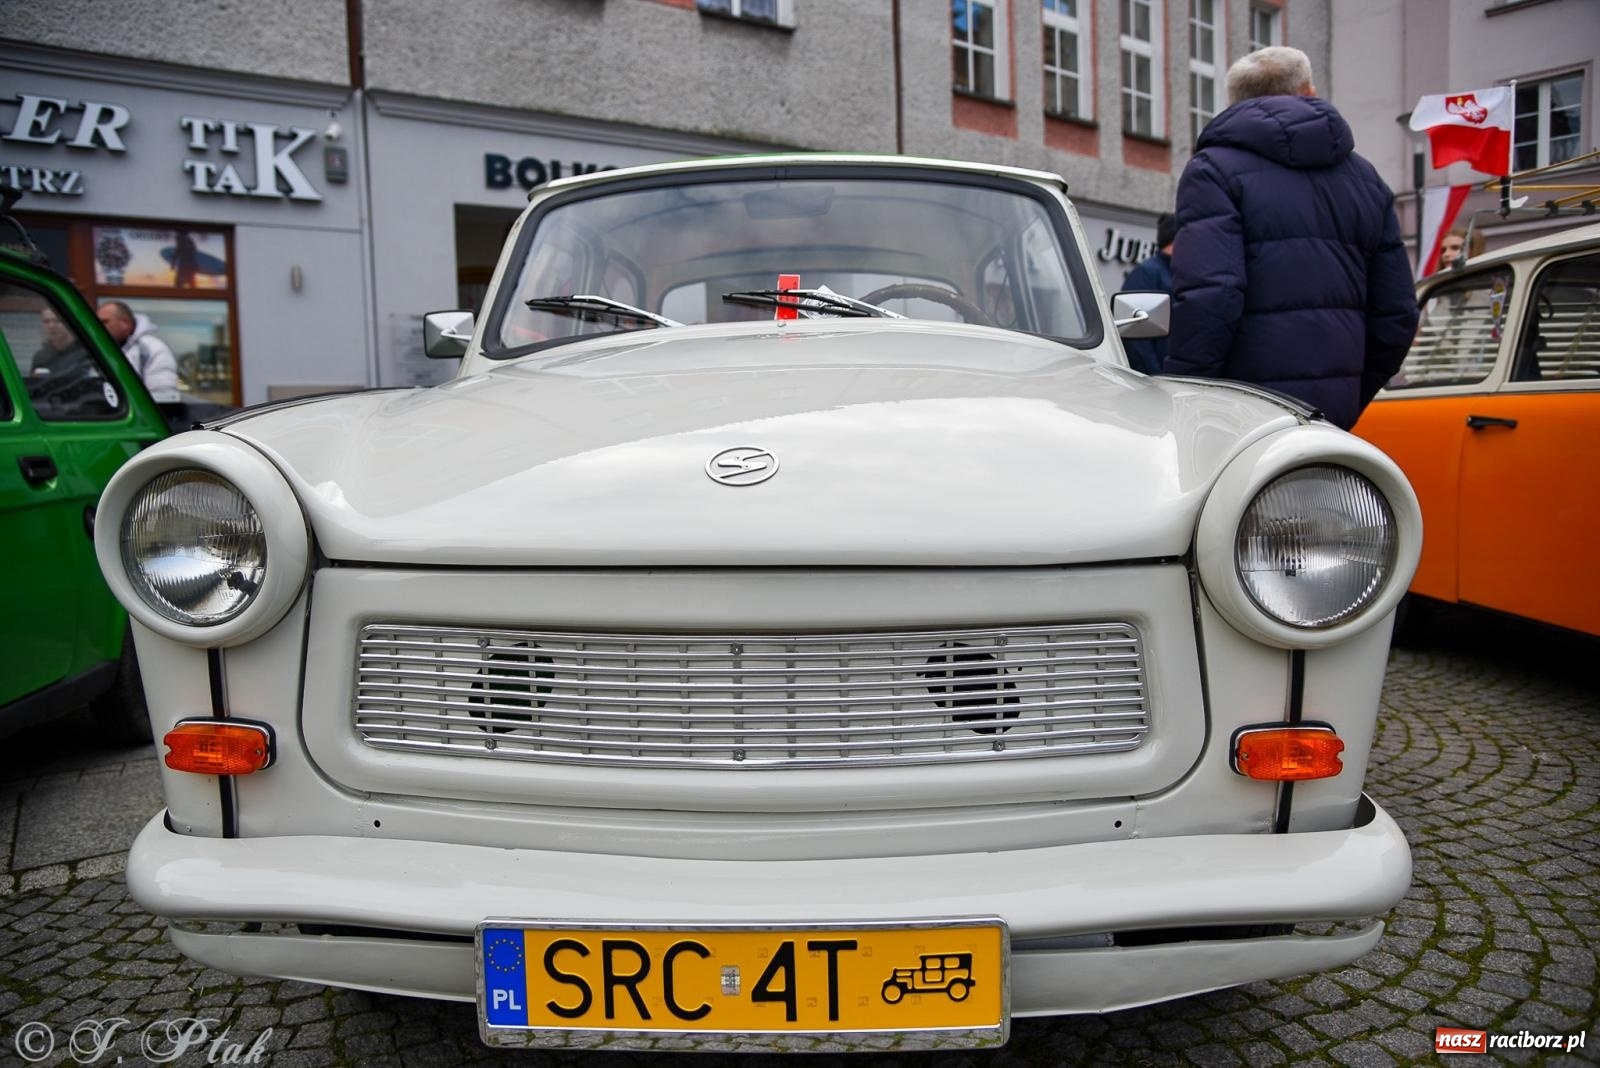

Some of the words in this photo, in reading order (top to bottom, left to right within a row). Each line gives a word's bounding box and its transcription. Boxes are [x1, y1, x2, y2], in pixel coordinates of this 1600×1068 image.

[0, 165, 84, 195] TRZ
[543, 938, 713, 1021] SRC
[751, 939, 858, 1022] 4T
[493, 989, 522, 1011] PL
